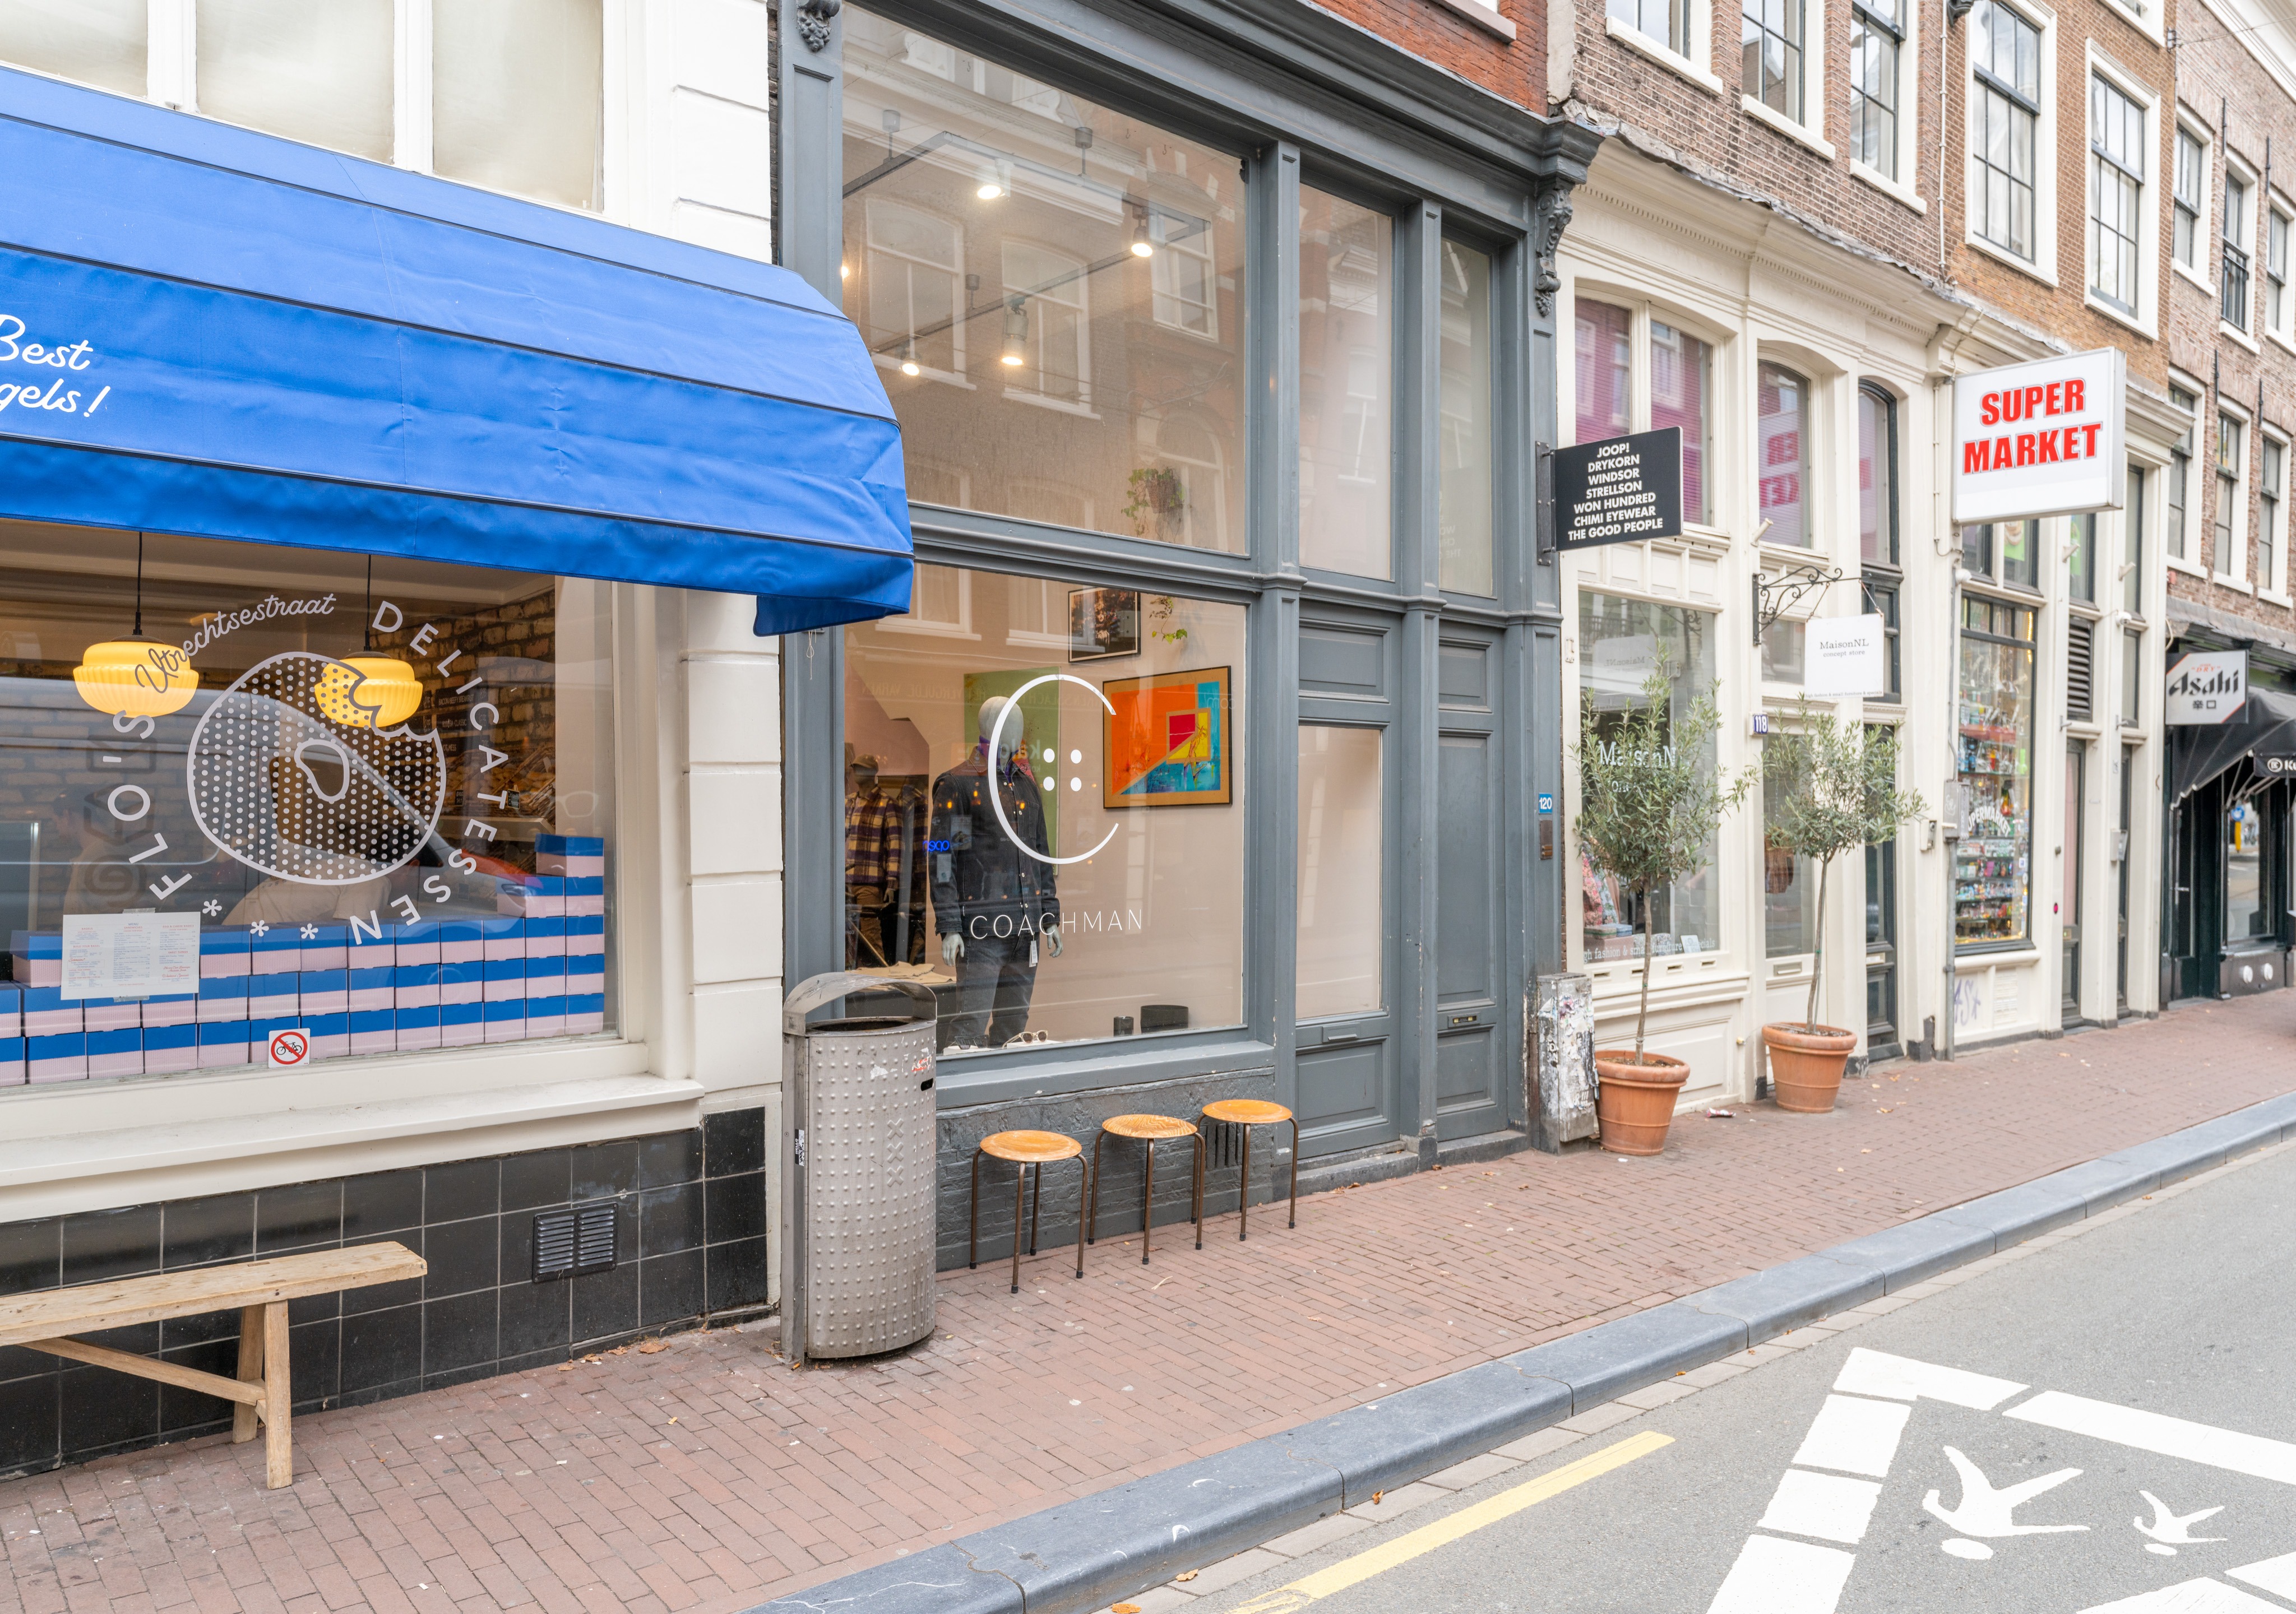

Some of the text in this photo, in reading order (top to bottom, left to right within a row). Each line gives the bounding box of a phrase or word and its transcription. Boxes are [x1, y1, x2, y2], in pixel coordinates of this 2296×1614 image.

[0, 314, 94, 370] Best
[1980, 377, 2086, 427] SUPER
[1596, 442, 1630, 458] JOOP!
[1962, 421, 2103, 475] MARKET
[1587, 454, 1640, 472] DRYKORN
[1587, 468, 1640, 485] WINDSOR
[1586, 481, 1642, 499] STRELLSON
[1573, 492, 1656, 514] WON HUNDRED
[1573, 505, 1656, 527] CHIMI EYEWEAR
[1568, 518, 1663, 541] THE GOOD PEOPLE
[1820, 639, 1869, 650] MaisonNL
[2168, 669, 2239, 697] Asahi
[1754, 715, 1767, 732] 118
[1539, 797, 1553, 810] 120
[1968, 805, 2011, 837] UPERMARKET
[970, 908, 1143, 940] COACHMAN
[1594, 947, 1621, 959] fashion
[1630, 946, 1645, 956] sma
